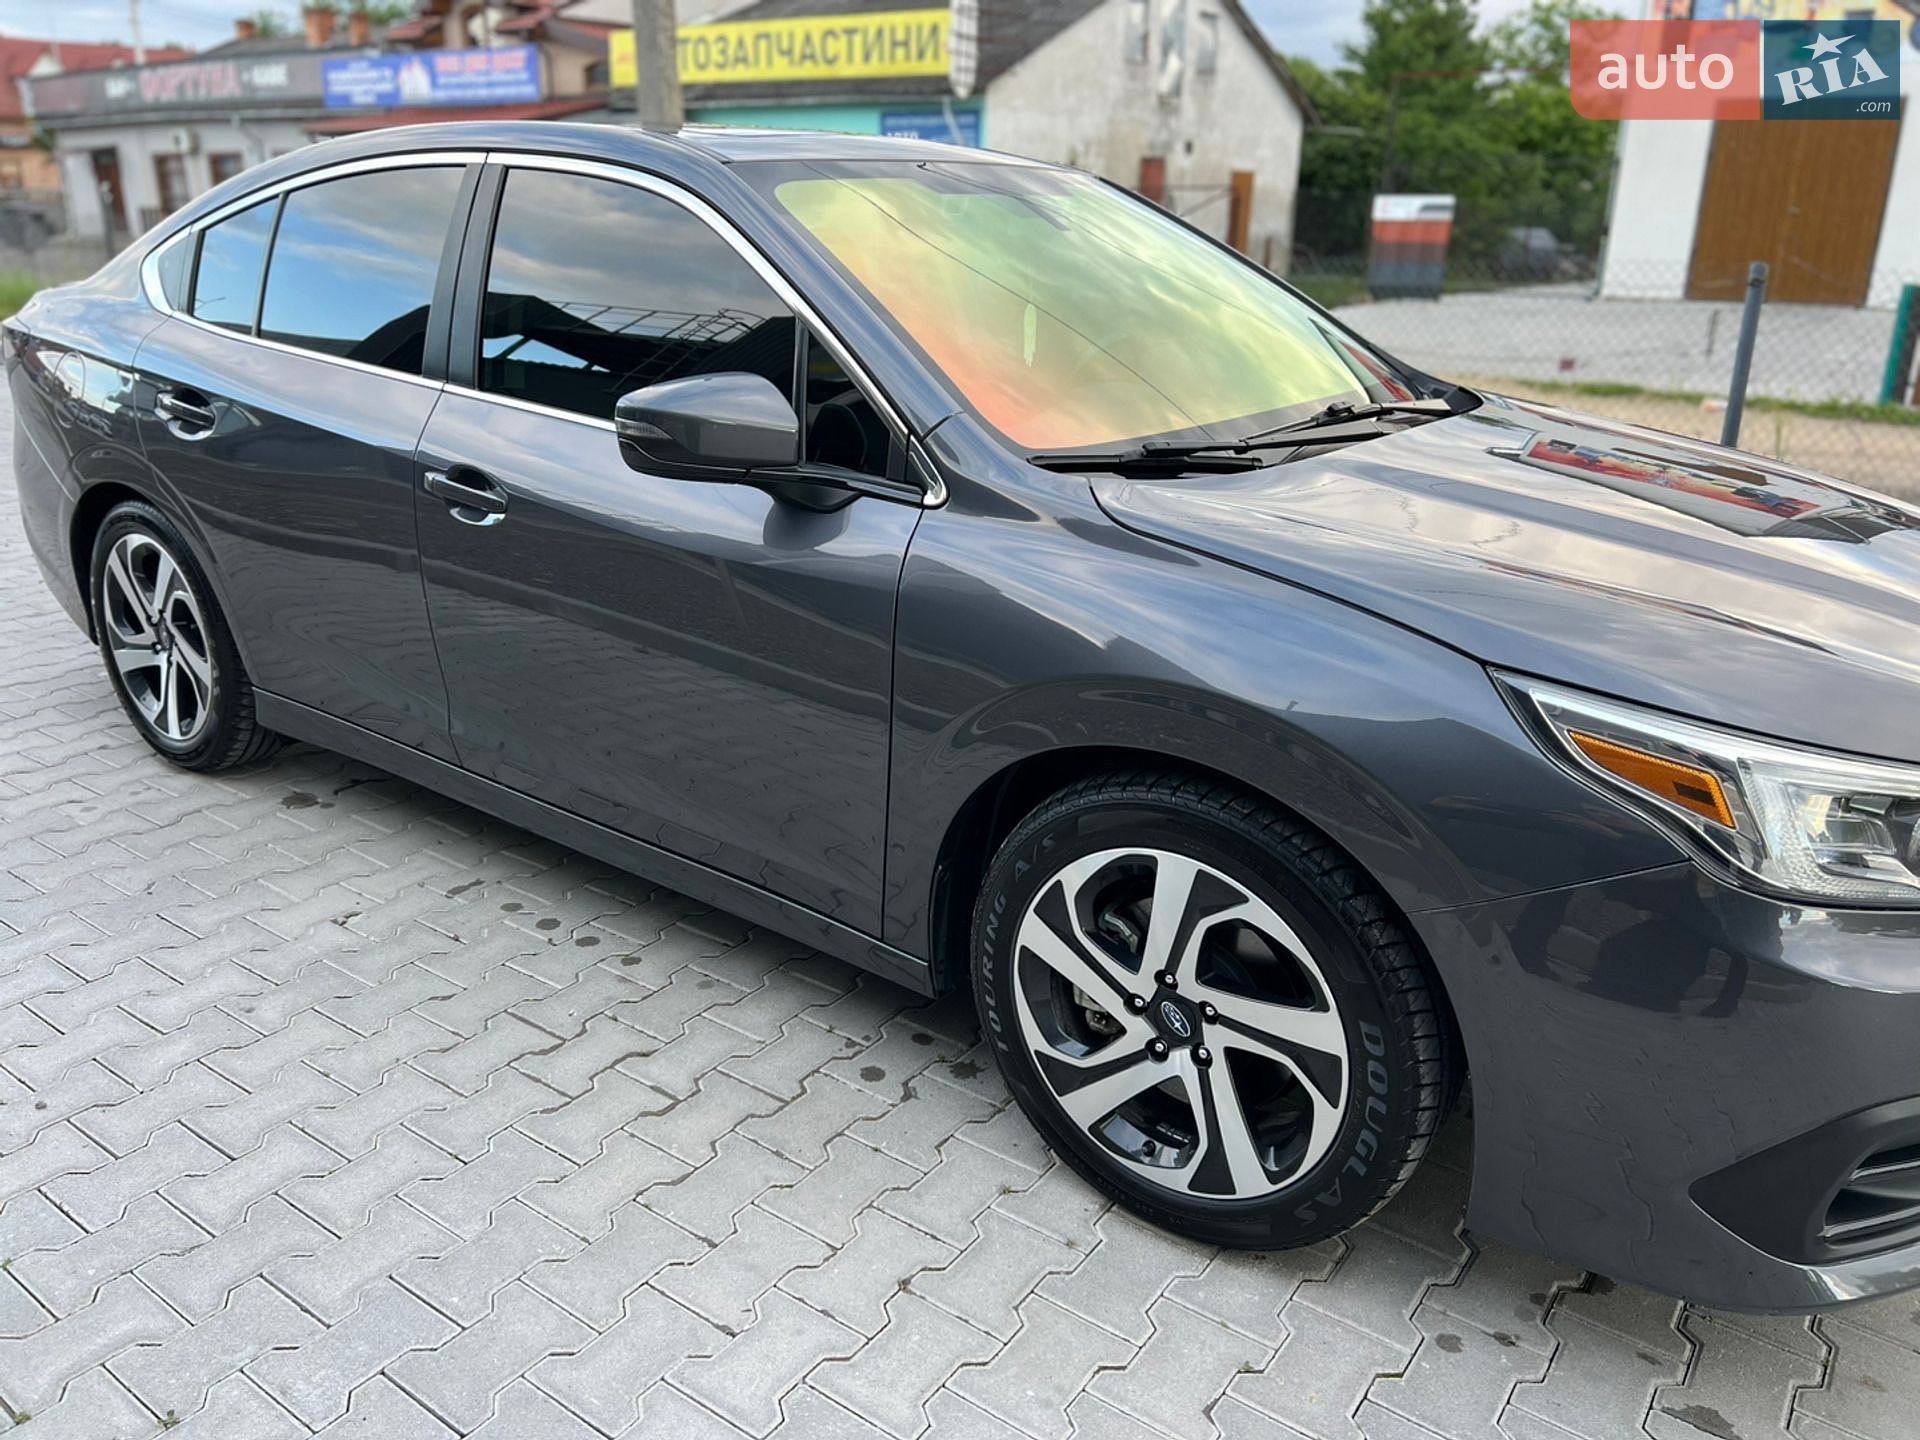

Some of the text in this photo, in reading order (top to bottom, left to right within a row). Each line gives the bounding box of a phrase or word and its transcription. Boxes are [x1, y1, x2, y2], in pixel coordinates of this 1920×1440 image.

[677, 22, 940, 71] ТОЗАПЧАСТИНИ
[982, 893, 1009, 1052] TOURING
[1294, 1019, 1389, 1227] DOUGLAS
